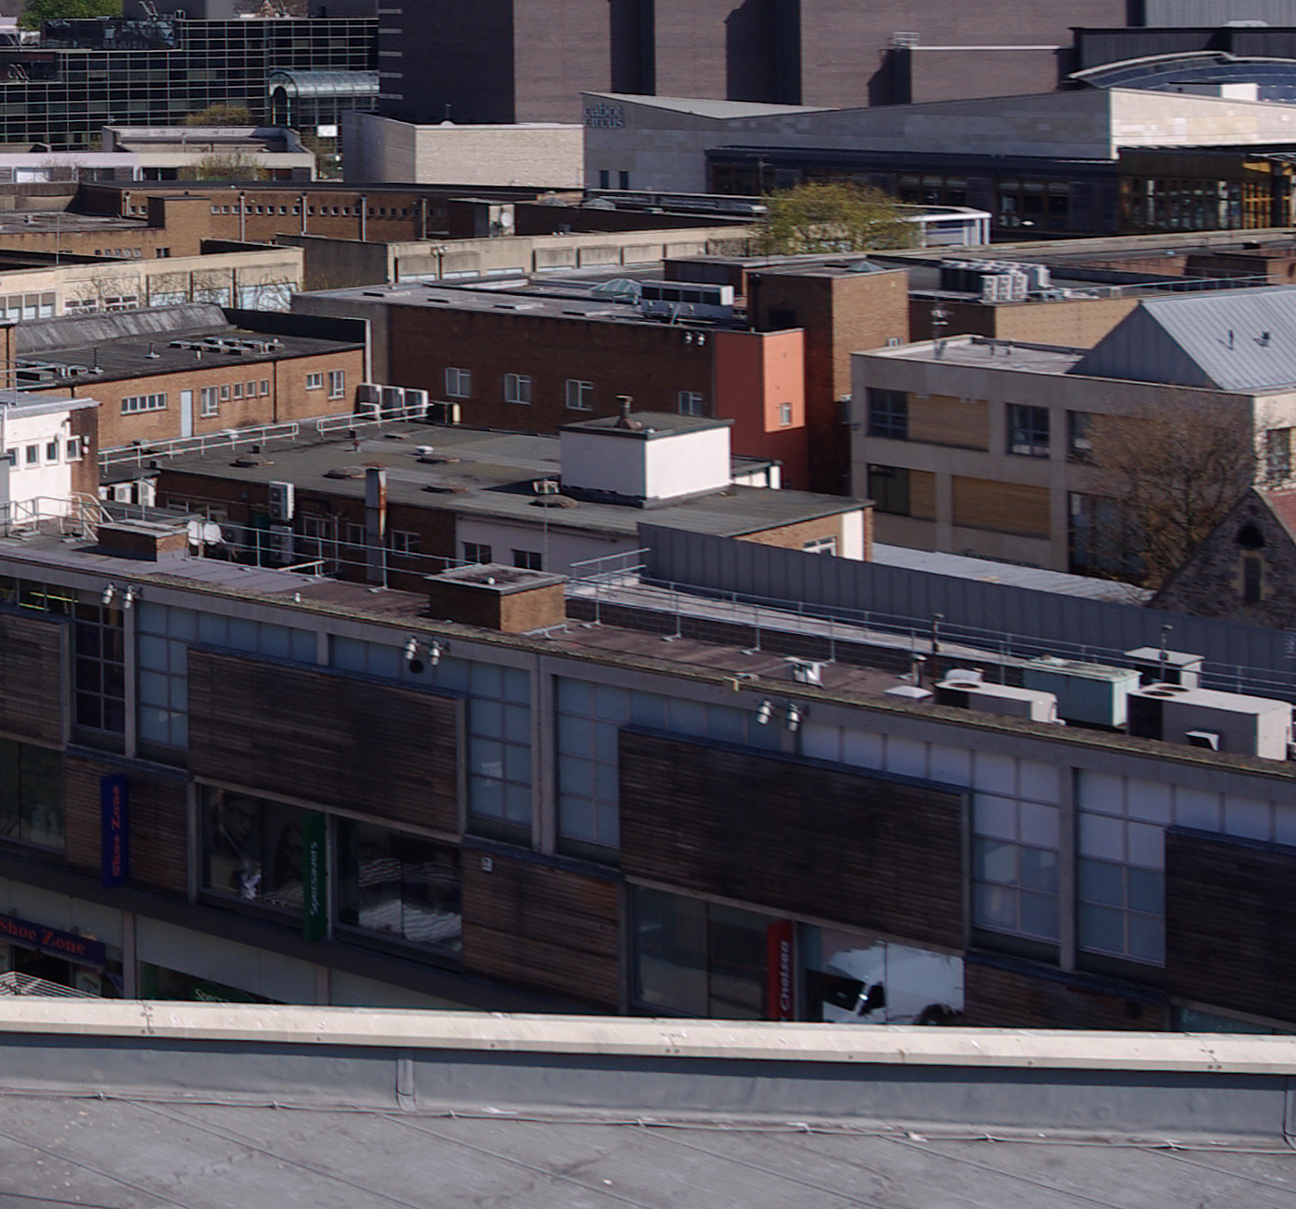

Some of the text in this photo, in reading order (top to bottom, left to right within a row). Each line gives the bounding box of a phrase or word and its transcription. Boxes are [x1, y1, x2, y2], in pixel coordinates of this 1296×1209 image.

[584, 103, 622, 117] cabot
[585, 118, 624, 128] circus
[110, 785, 121, 878] Shoe Zone
[41, 929, 85, 955] Zone
[779, 940, 790, 1012] Chelsea
